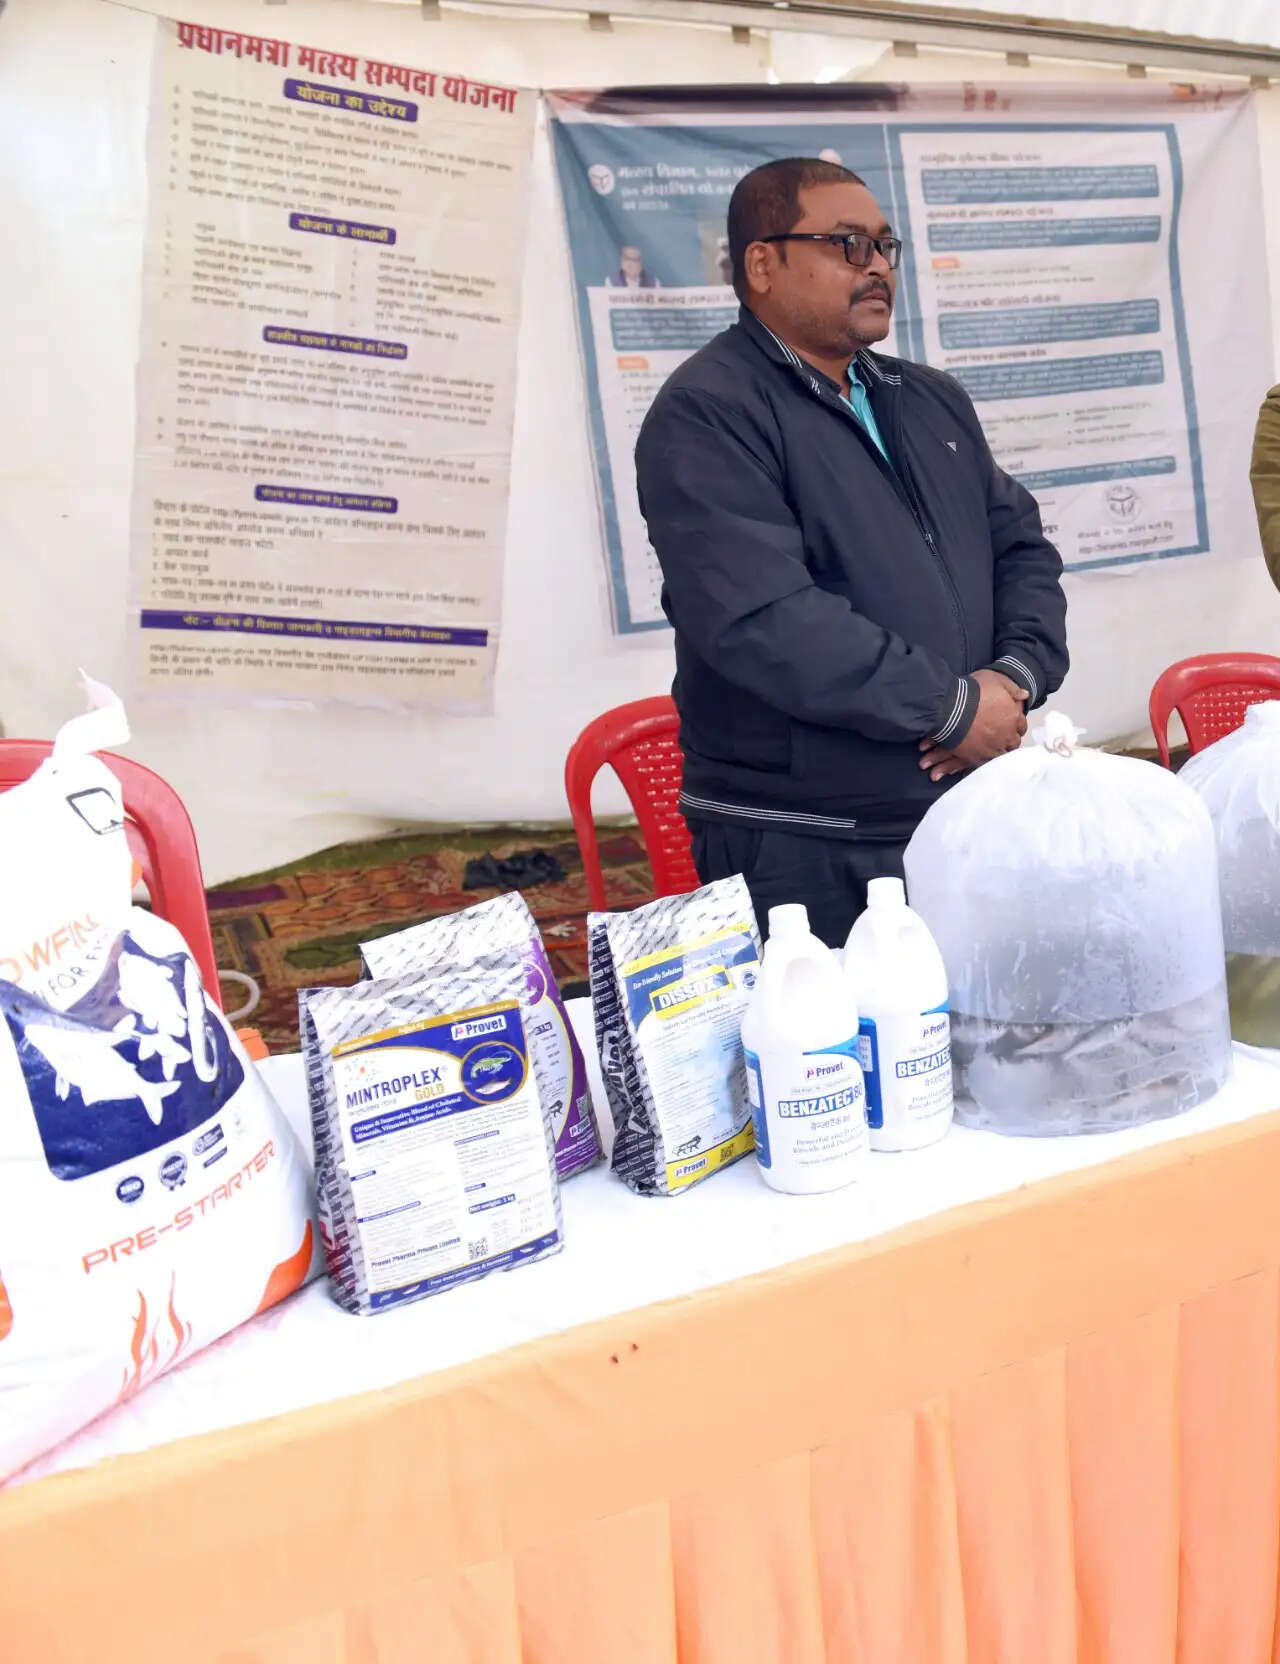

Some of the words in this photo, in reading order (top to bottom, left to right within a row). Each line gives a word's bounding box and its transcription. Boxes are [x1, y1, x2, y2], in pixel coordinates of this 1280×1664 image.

[465, 1017, 504, 1036] Provet
[816, 1061, 844, 1077] Provet
[345, 1066, 442, 1109] MINTROPLEX
[415, 1083, 445, 1101] GOLD
[779, 1088, 853, 1118] BENZATEC
[81, 1140, 275, 1274] PRE-STARTER
